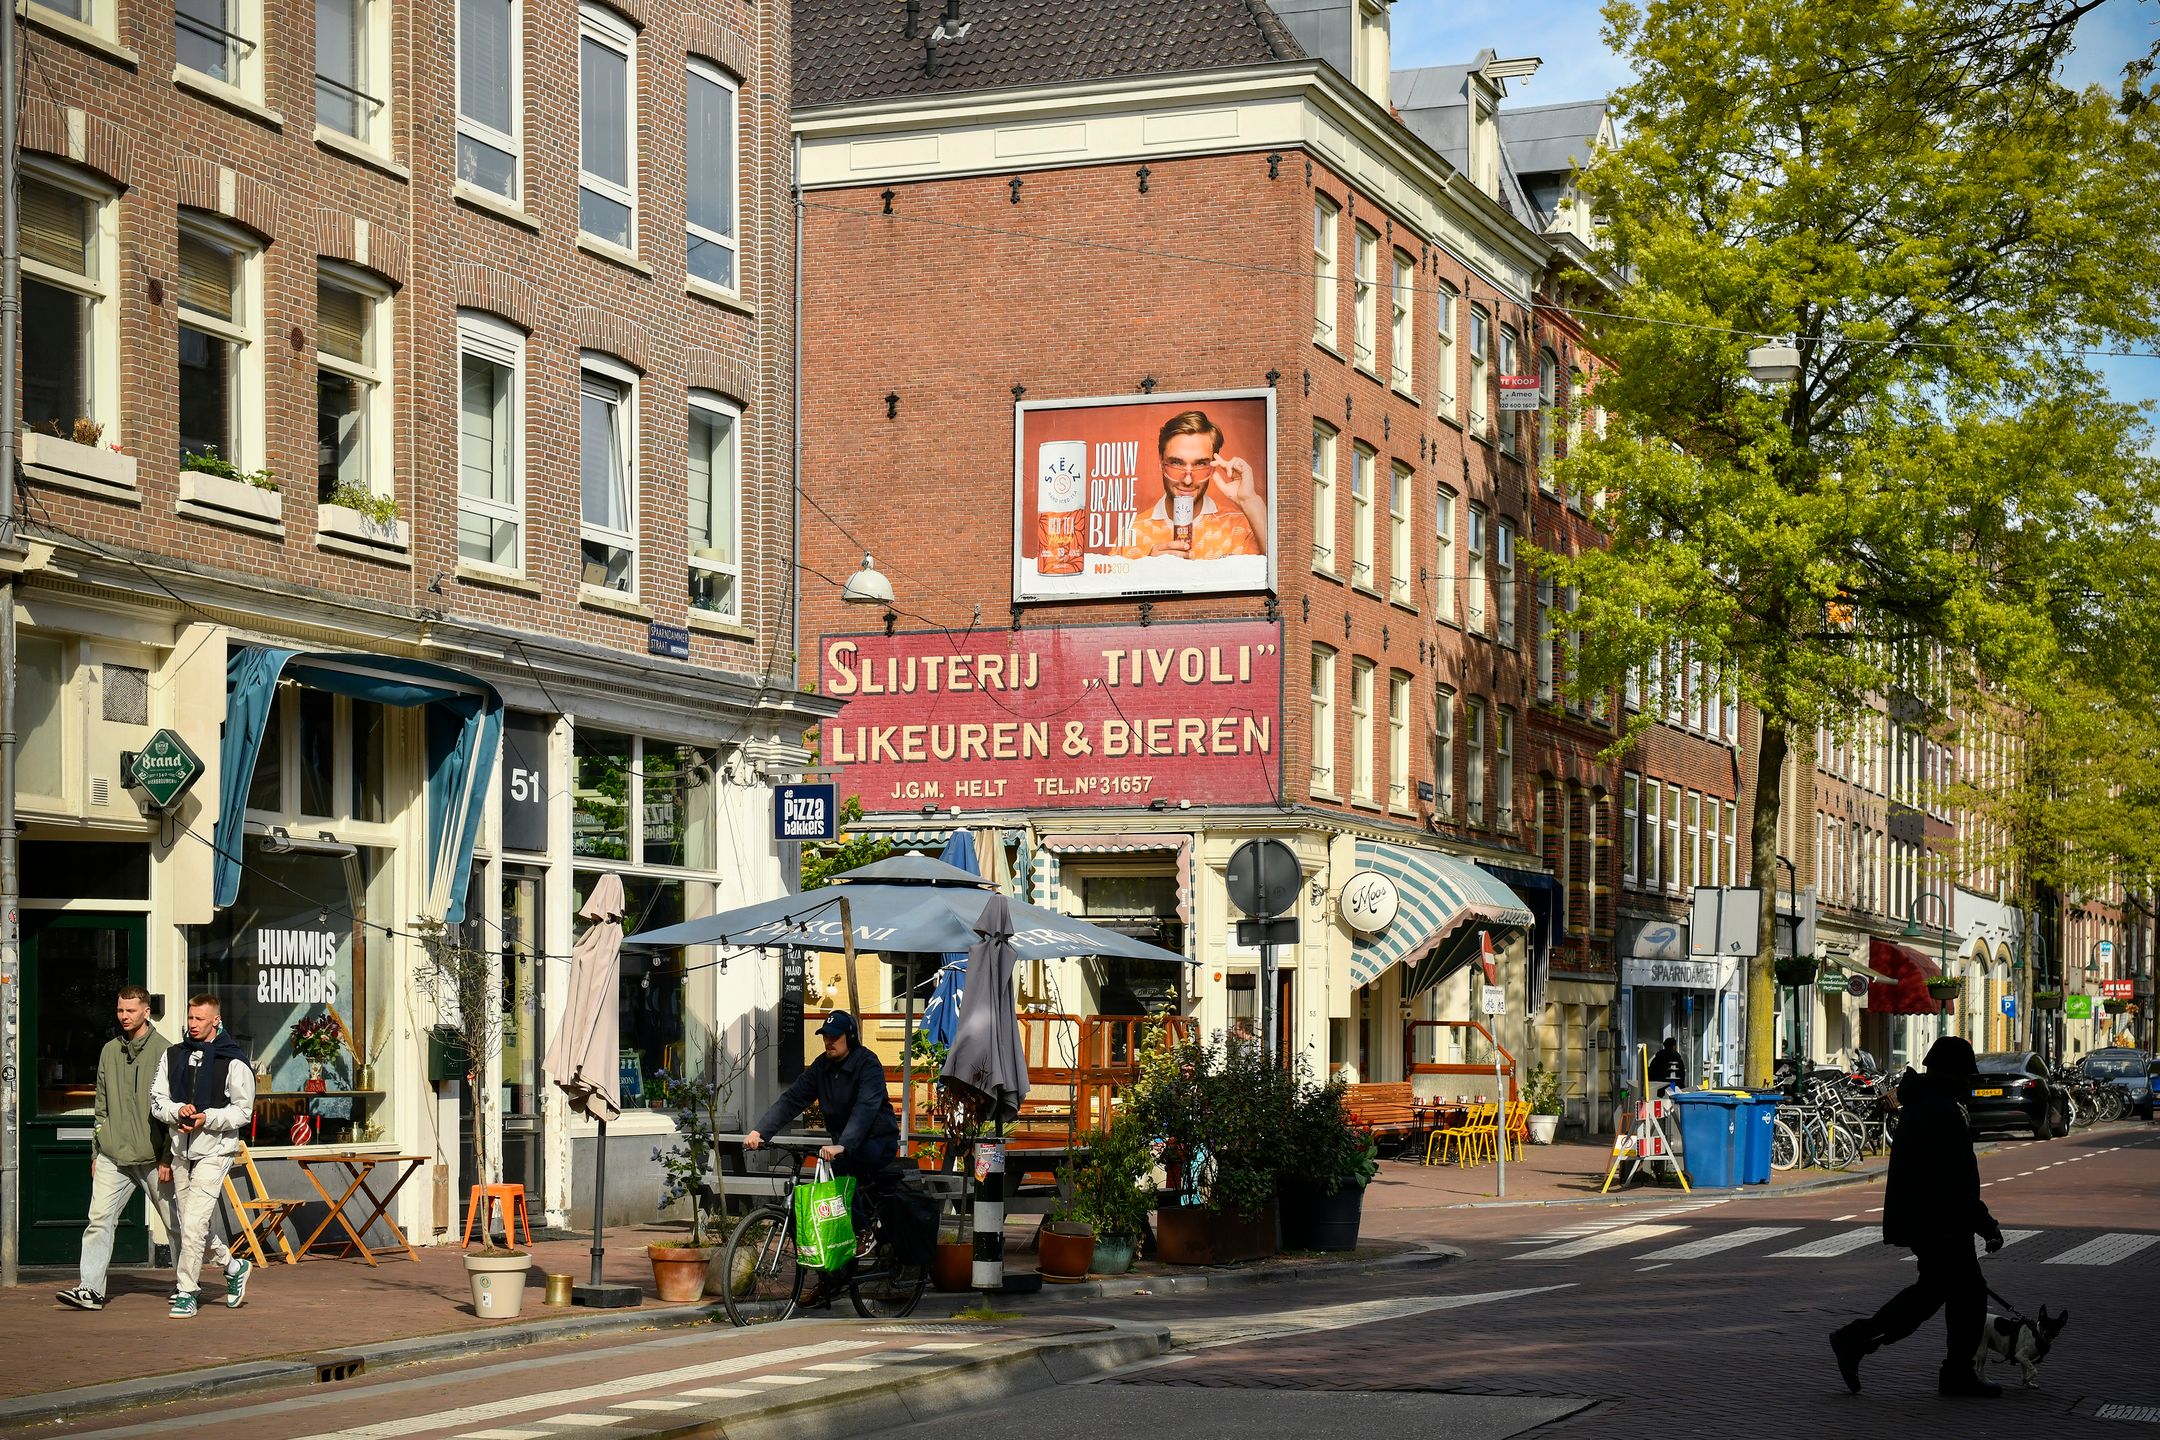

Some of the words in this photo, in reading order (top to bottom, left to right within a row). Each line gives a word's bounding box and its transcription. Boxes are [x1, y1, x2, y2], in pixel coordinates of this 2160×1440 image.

[1044, 457, 1081, 483] STËLZ
[1090, 441, 1139, 477] JOUW
[1090, 477, 1138, 512] ORANJE
[1089, 512, 1138, 548] BLIK
[650, 638, 668, 651] STRAAT
[828, 641, 1039, 694] SLIJTERIJ
[832, 721, 1049, 763] LIKEUREN
[1062, 721, 1093, 757] &
[1103, 716, 1271, 757] BIEREN
[142, 753, 182, 769] Brand
[510, 768, 539, 803] 51
[784, 789, 794, 798] de
[891, 781, 944, 799] J.G.M.
[955, 778, 1007, 798] HELT
[1100, 776, 1153, 794] 31657
[784, 820, 825, 836] bakkers
[1352, 881, 1387, 914] Moos
[258, 928, 336, 967] HUMMUS
[2104, 983, 2132, 992] JELLE
